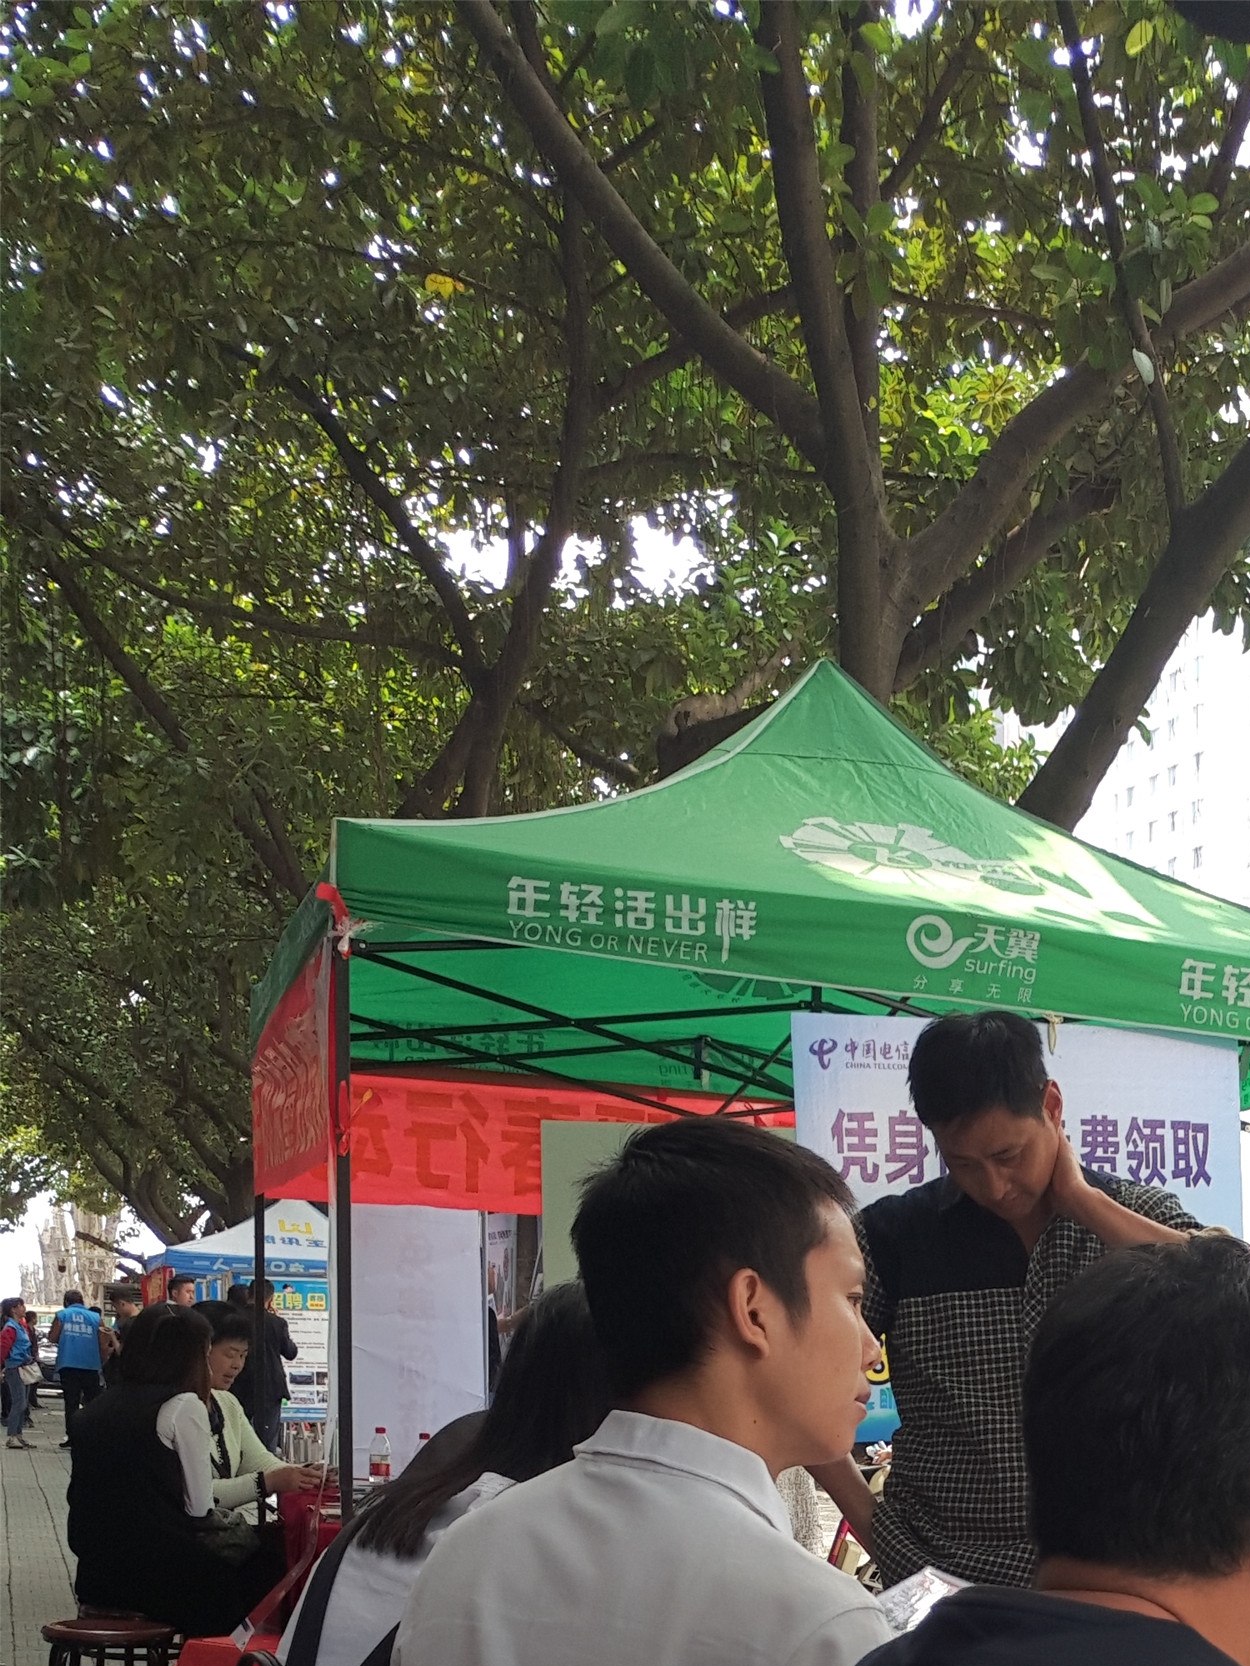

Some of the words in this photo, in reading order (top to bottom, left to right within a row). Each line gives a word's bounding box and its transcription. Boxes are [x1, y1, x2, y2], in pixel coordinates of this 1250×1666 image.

[507, 875, 758, 965] 年轻活出样
[509, 920, 582, 947] YONG
[590, 934, 619, 951] OR
[627, 934, 709, 963] NEVER
[968, 923, 1041, 964] 天翼
[965, 959, 1037, 985] surfing
[1180, 1003, 1240, 1029] YONG
[844, 1038, 910, 1061] 中国电信
[846, 1061, 872, 1070] CHINA
